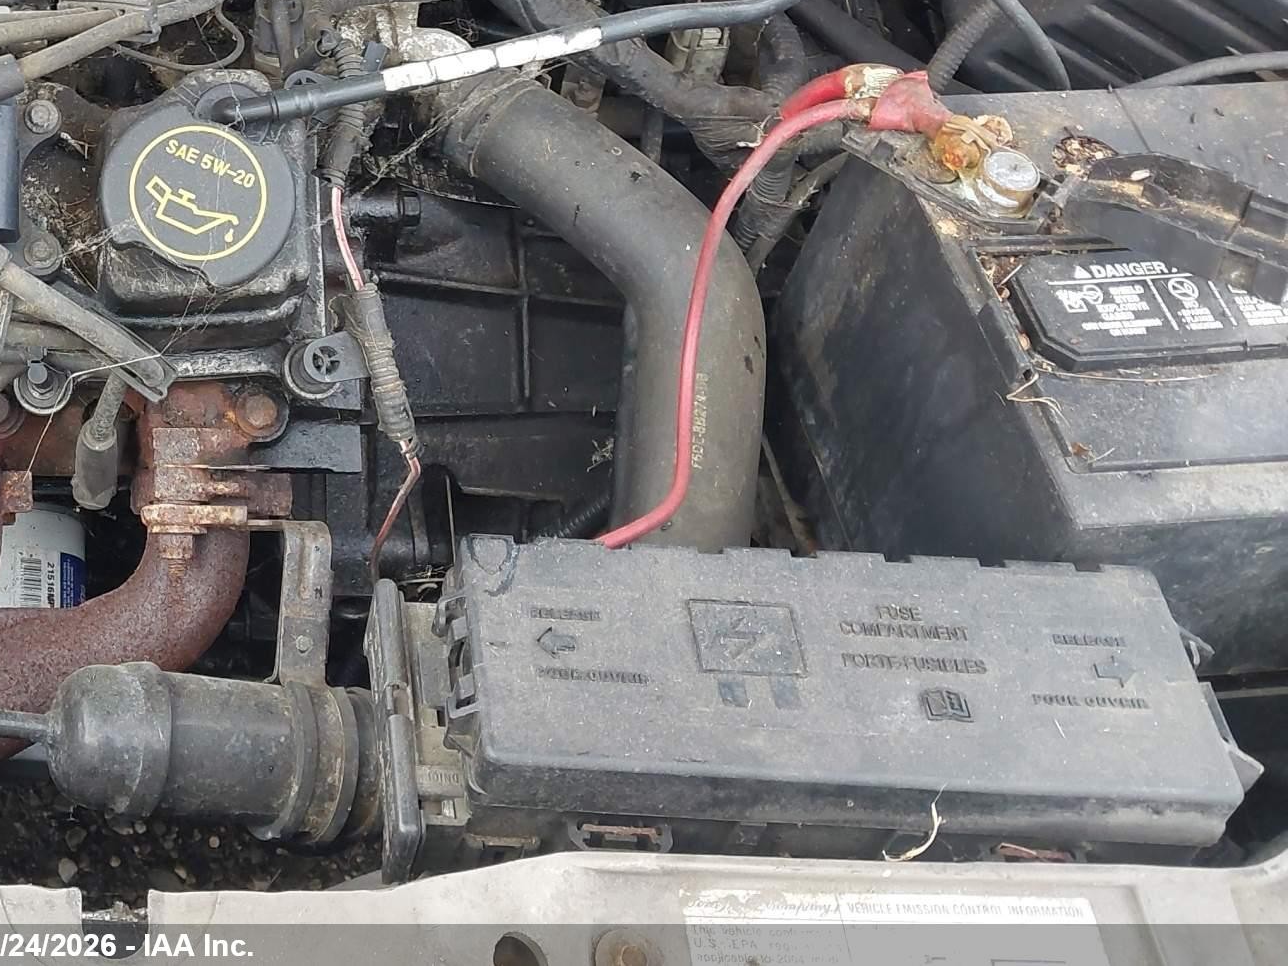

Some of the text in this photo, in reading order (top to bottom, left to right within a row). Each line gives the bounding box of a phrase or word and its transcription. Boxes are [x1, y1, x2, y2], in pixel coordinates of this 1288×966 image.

[165, 139, 256, 188] SAE 5W-20
[1090, 261, 1170, 279] DANGER
[878, 605, 923, 622] FUSE
[840, 622, 969, 641] COMPARTMENT
[846, 902, 1084, 918] VEHICLE EMISSION CONTROL INFORMATION
